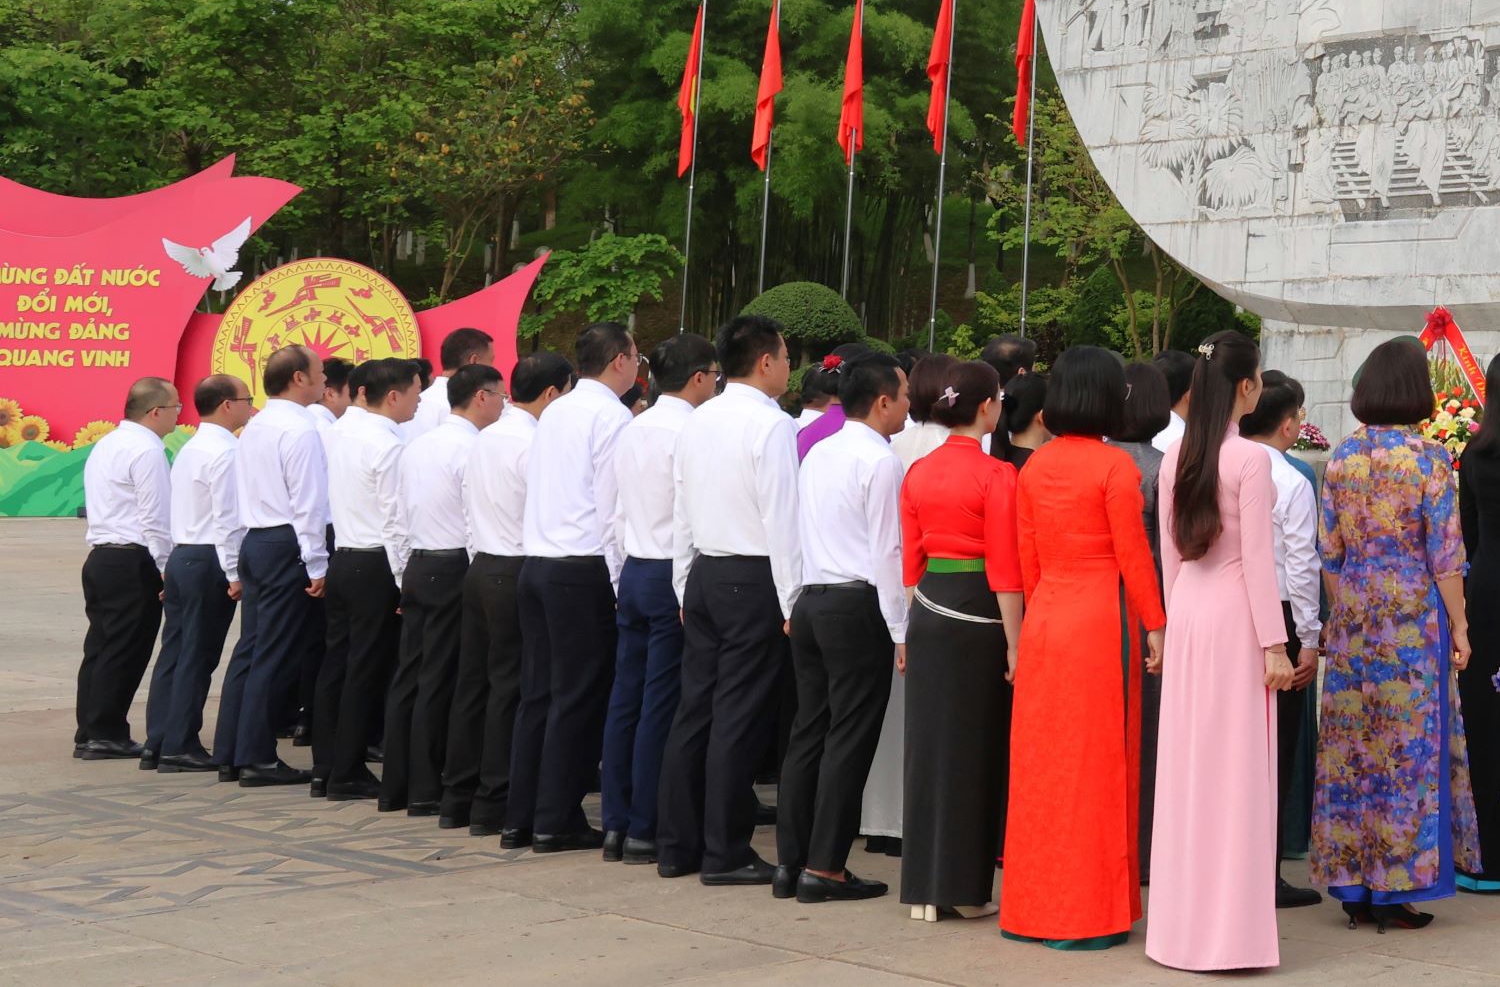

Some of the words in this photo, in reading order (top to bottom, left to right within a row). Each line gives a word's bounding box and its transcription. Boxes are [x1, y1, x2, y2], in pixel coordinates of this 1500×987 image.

[0, 262, 48, 285] ỪNG
[53, 262, 95, 286] ĐẤT
[100, 264, 161, 287] NƯỚC
[16, 287, 57, 312] ĐỔI
[63, 290, 113, 317] MỚI,
[0, 316, 61, 340] MỪNG
[68, 317, 130, 341] ĐẢNG
[0, 348, 75, 368] QUANG
[80, 349, 131, 367] VINH
